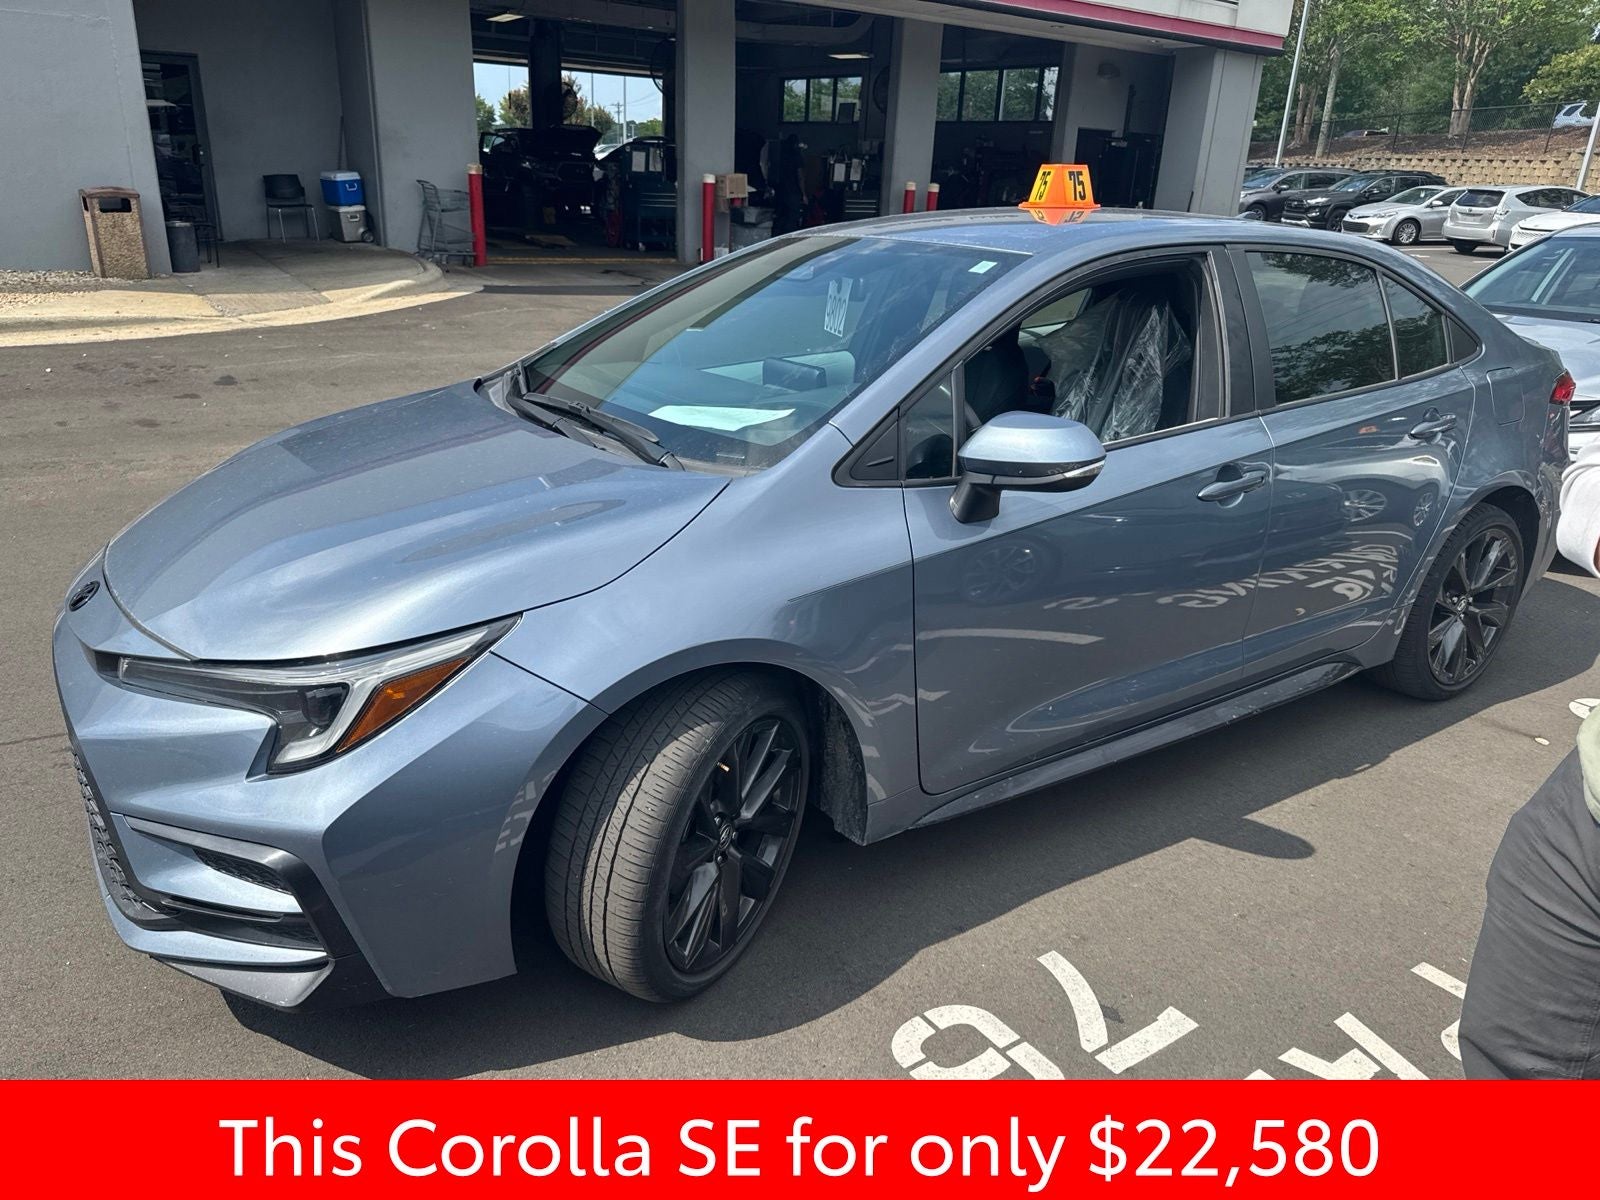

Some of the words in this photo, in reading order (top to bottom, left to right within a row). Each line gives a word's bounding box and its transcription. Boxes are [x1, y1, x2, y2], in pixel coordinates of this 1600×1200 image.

[1034, 170, 1052, 201] 75
[1068, 170, 1087, 201] 75
[825, 294, 847, 334] 9802
